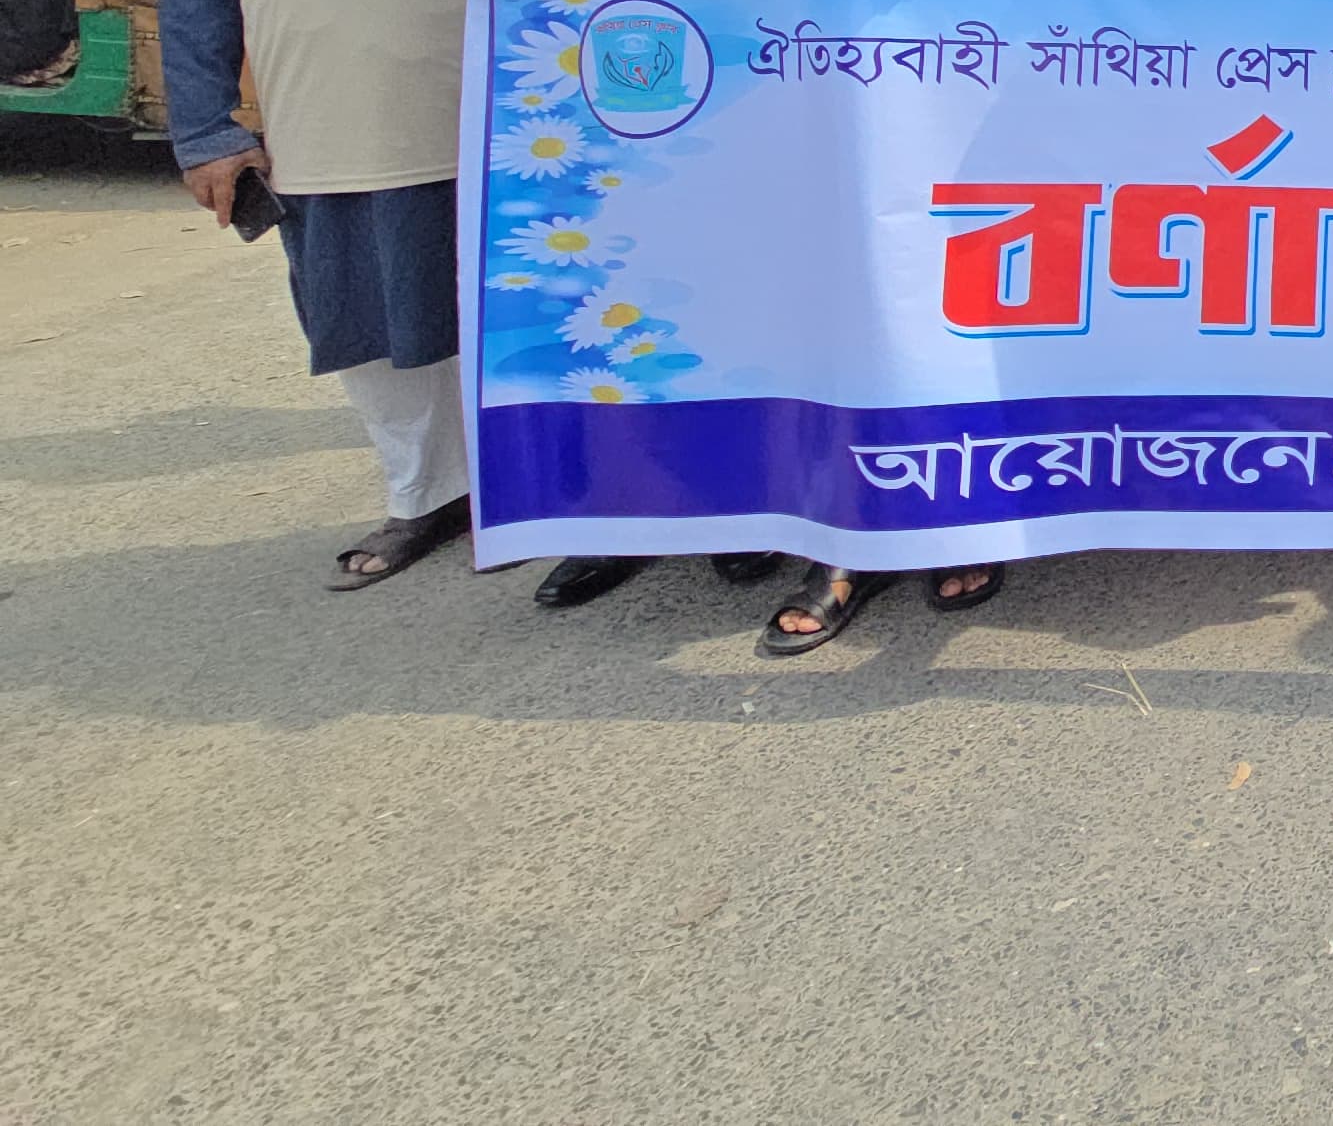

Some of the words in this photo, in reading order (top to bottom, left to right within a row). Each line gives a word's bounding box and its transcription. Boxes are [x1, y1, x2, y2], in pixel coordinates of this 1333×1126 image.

[747, 16, 1009, 90] ঐতিহ্যবাহী
[1026, 24, 1197, 90] সাঁথিয়া
[1216, 42, 1317, 96] প্রেস
